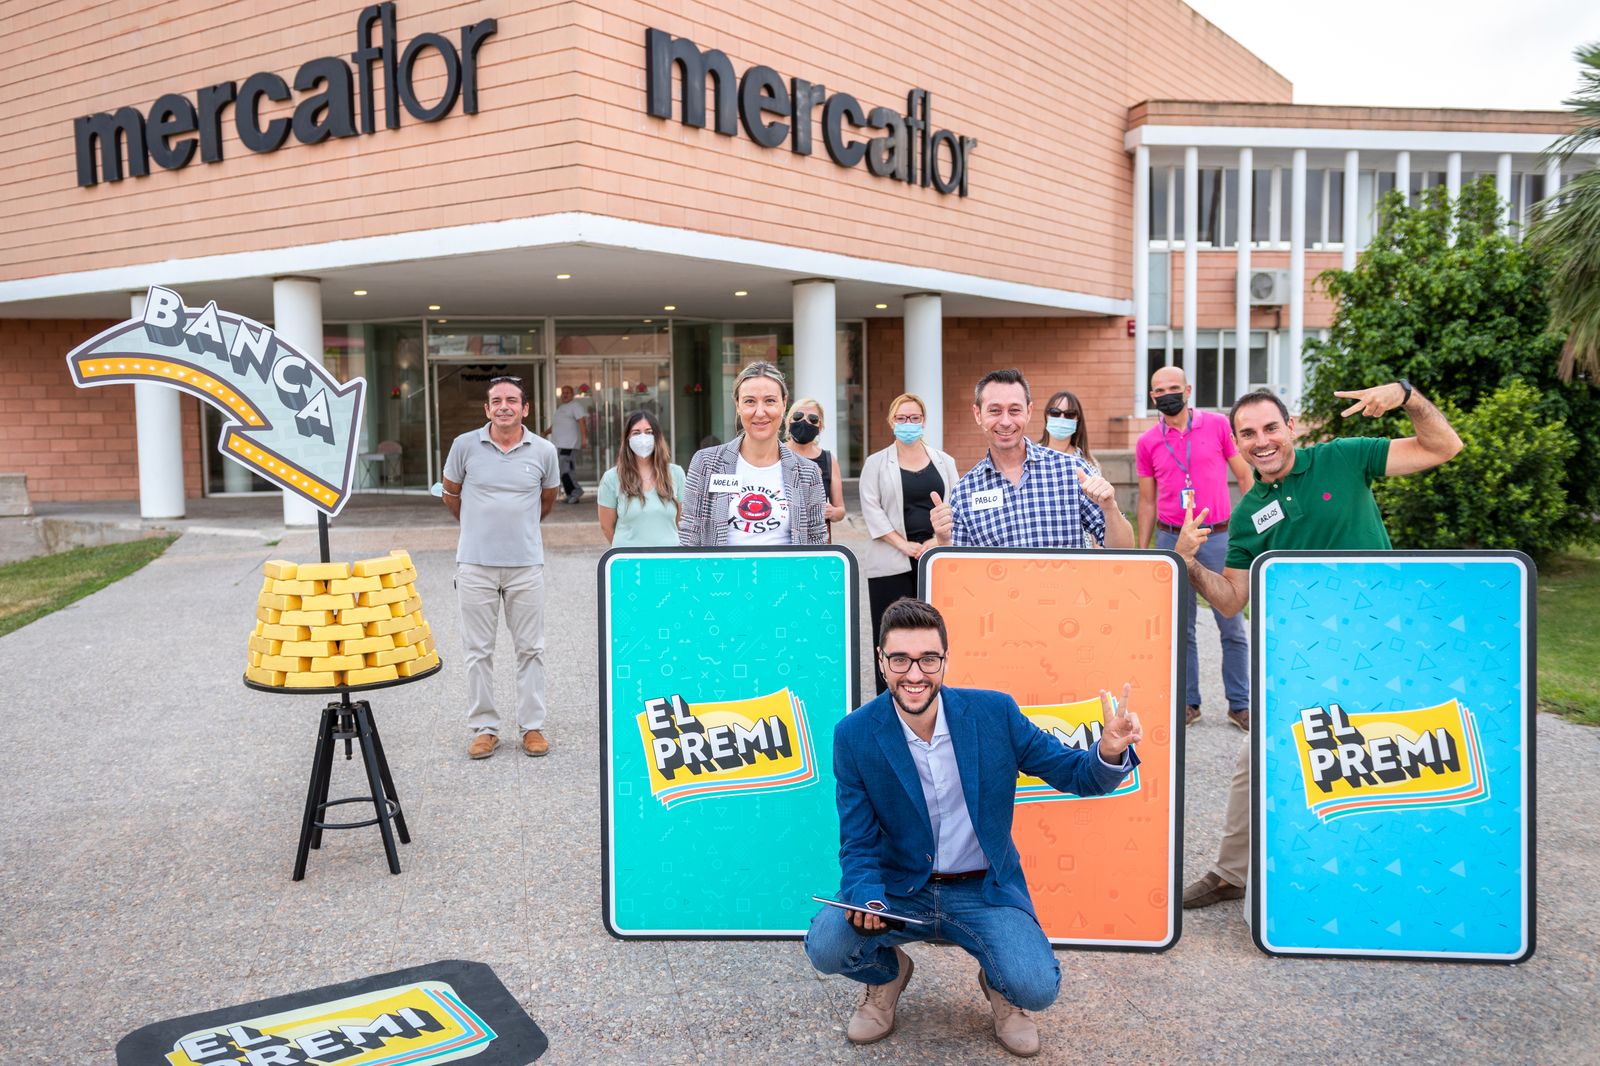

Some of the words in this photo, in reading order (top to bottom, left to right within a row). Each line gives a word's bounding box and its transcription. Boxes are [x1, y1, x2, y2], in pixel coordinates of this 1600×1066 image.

[74, 1, 497, 188] mercaflor
[646, 27, 977, 197] mercaflor
[144, 286, 335, 445] BANCA
[975, 496, 998, 505] PABLO
[1258, 508, 1278, 525] CARLOS
[727, 515, 781, 534] KISS
[644, 694, 700, 735] EL
[1300, 704, 1360, 746] EL
[651, 715, 788, 775] PREMI
[1308, 728, 1456, 787] PREMI
[179, 1026, 277, 1063] EL
